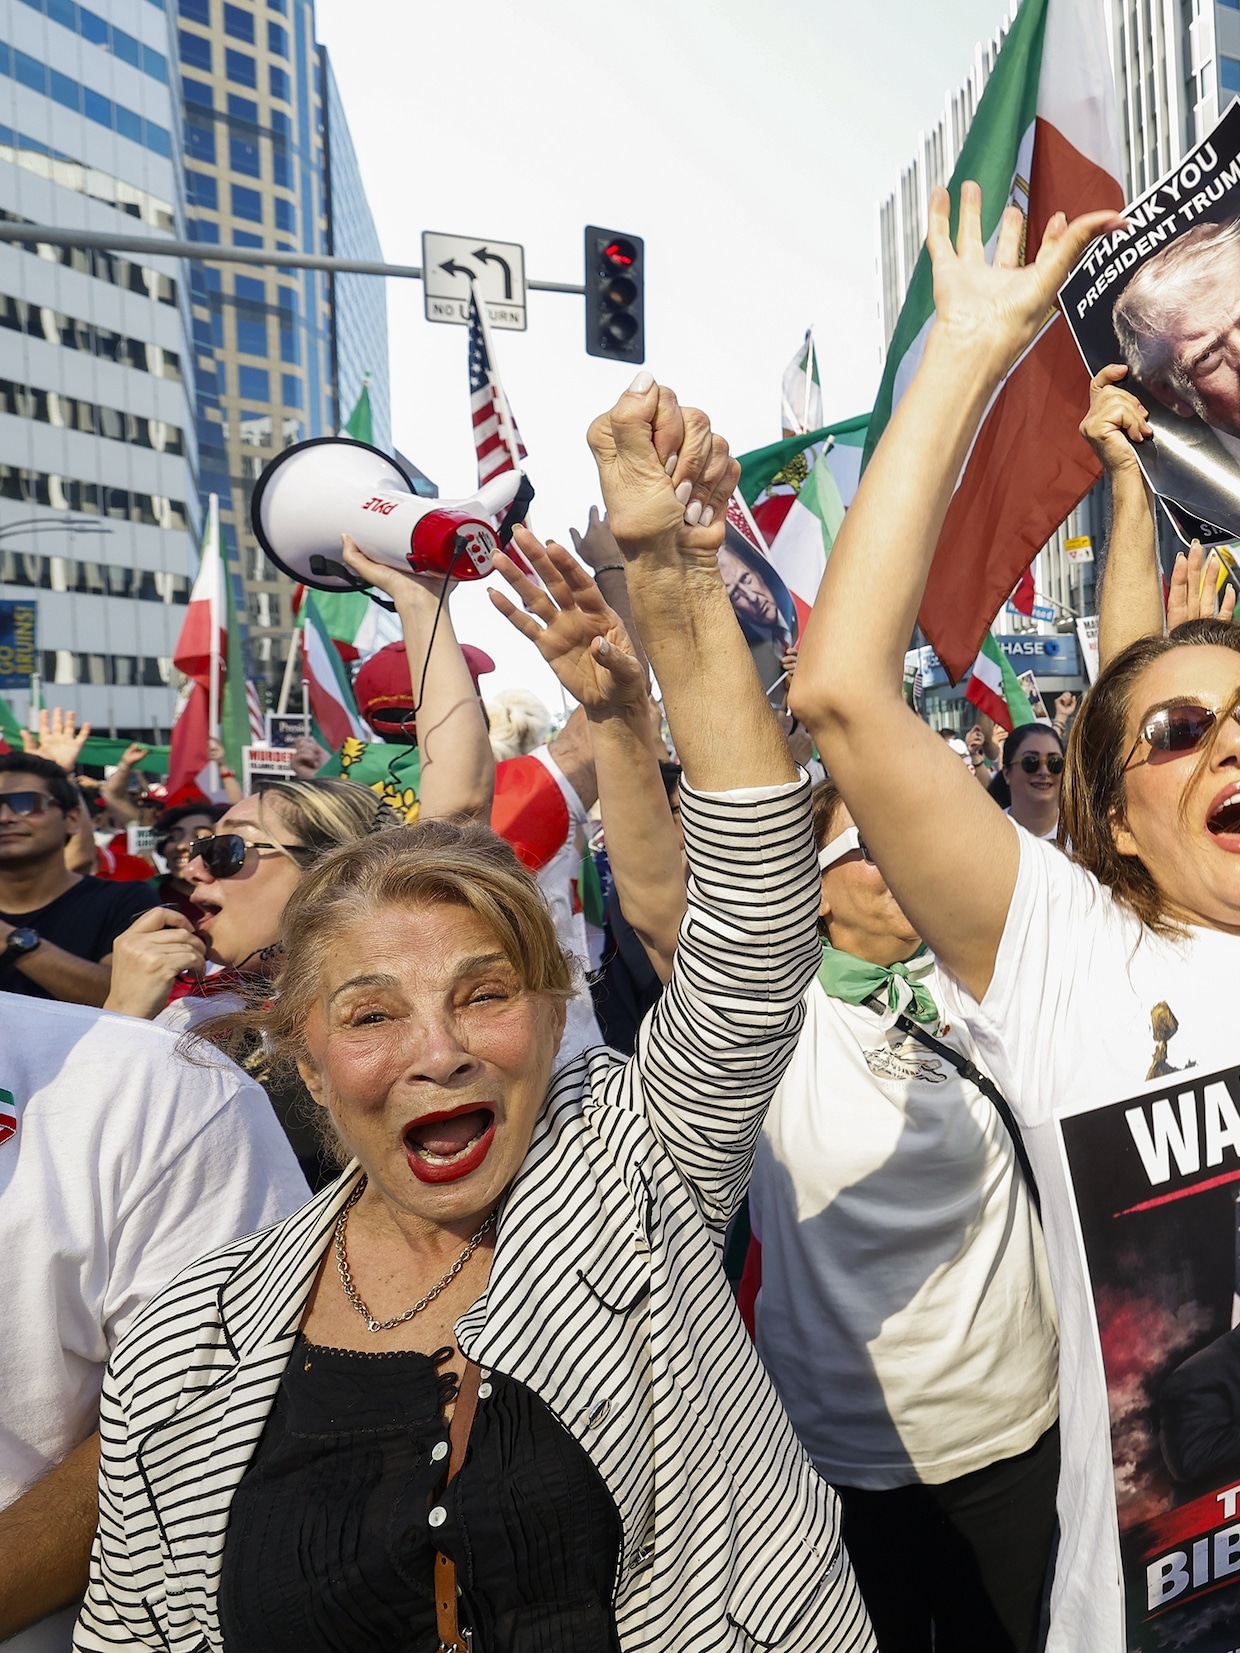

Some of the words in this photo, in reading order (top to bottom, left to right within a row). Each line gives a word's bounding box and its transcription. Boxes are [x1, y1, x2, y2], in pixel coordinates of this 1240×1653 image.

[1083, 194, 1166, 278] THANK
[1162, 142, 1218, 203] YOU
[1076, 215, 1178, 319] PRESIDENT
[432, 303, 455, 317] NO
[487, 307, 520, 323] URN
[361, 497, 399, 516] PYLE
[14, 606, 35, 674] BRUINS!
[999, 642, 1045, 655] HASE
[0, 646, 14, 675] GO
